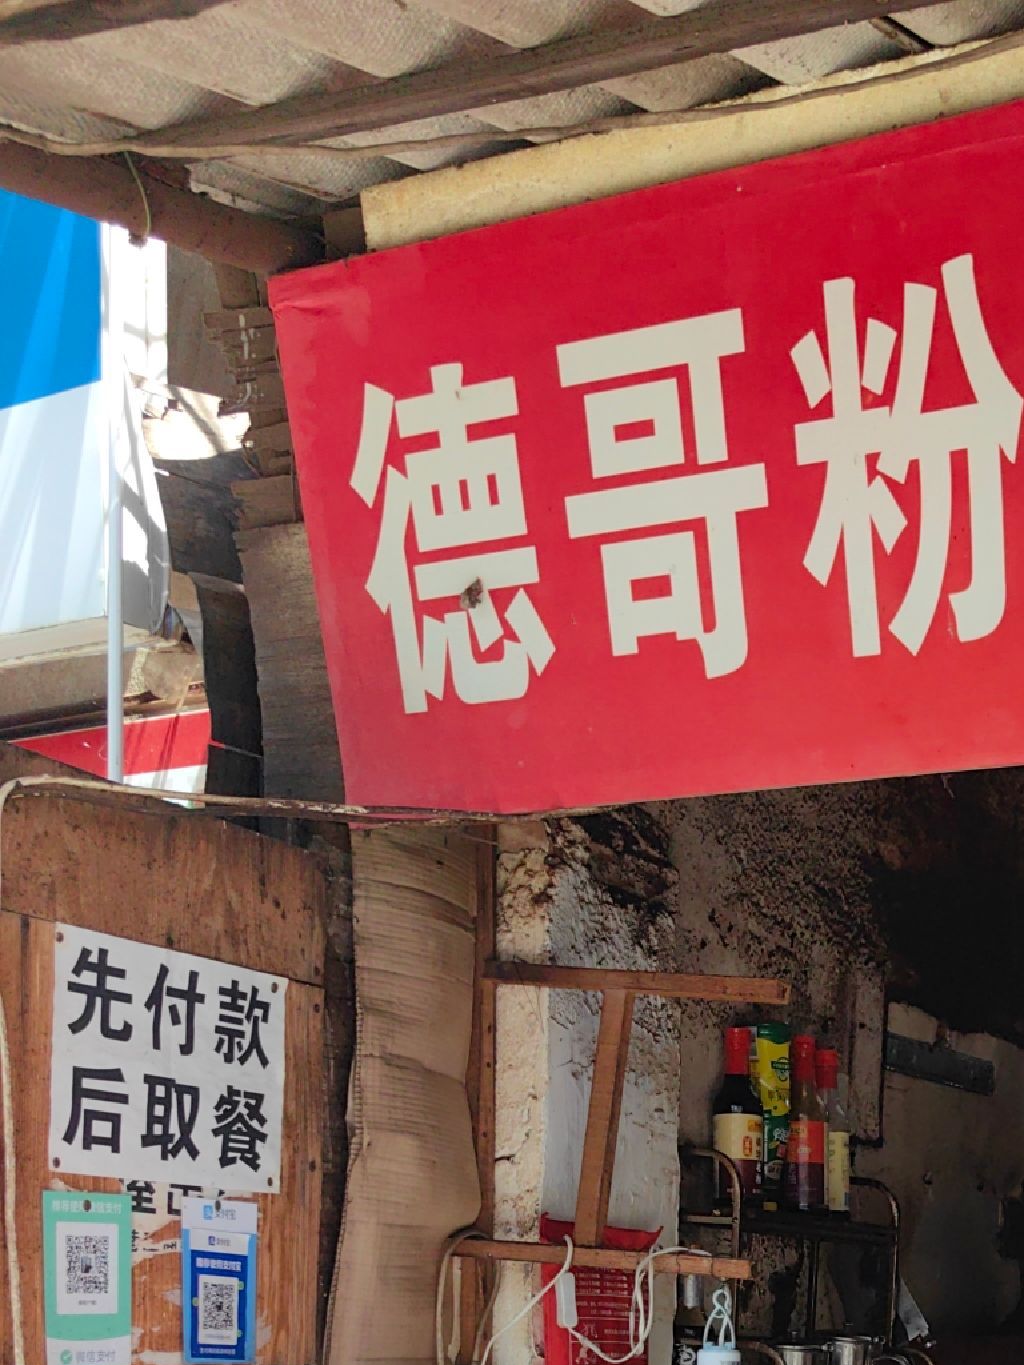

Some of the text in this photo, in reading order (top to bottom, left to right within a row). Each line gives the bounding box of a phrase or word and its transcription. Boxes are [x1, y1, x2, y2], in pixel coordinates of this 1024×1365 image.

[66, 946, 271, 1069] 先付款
[62, 1065, 269, 1173] 后取餐
